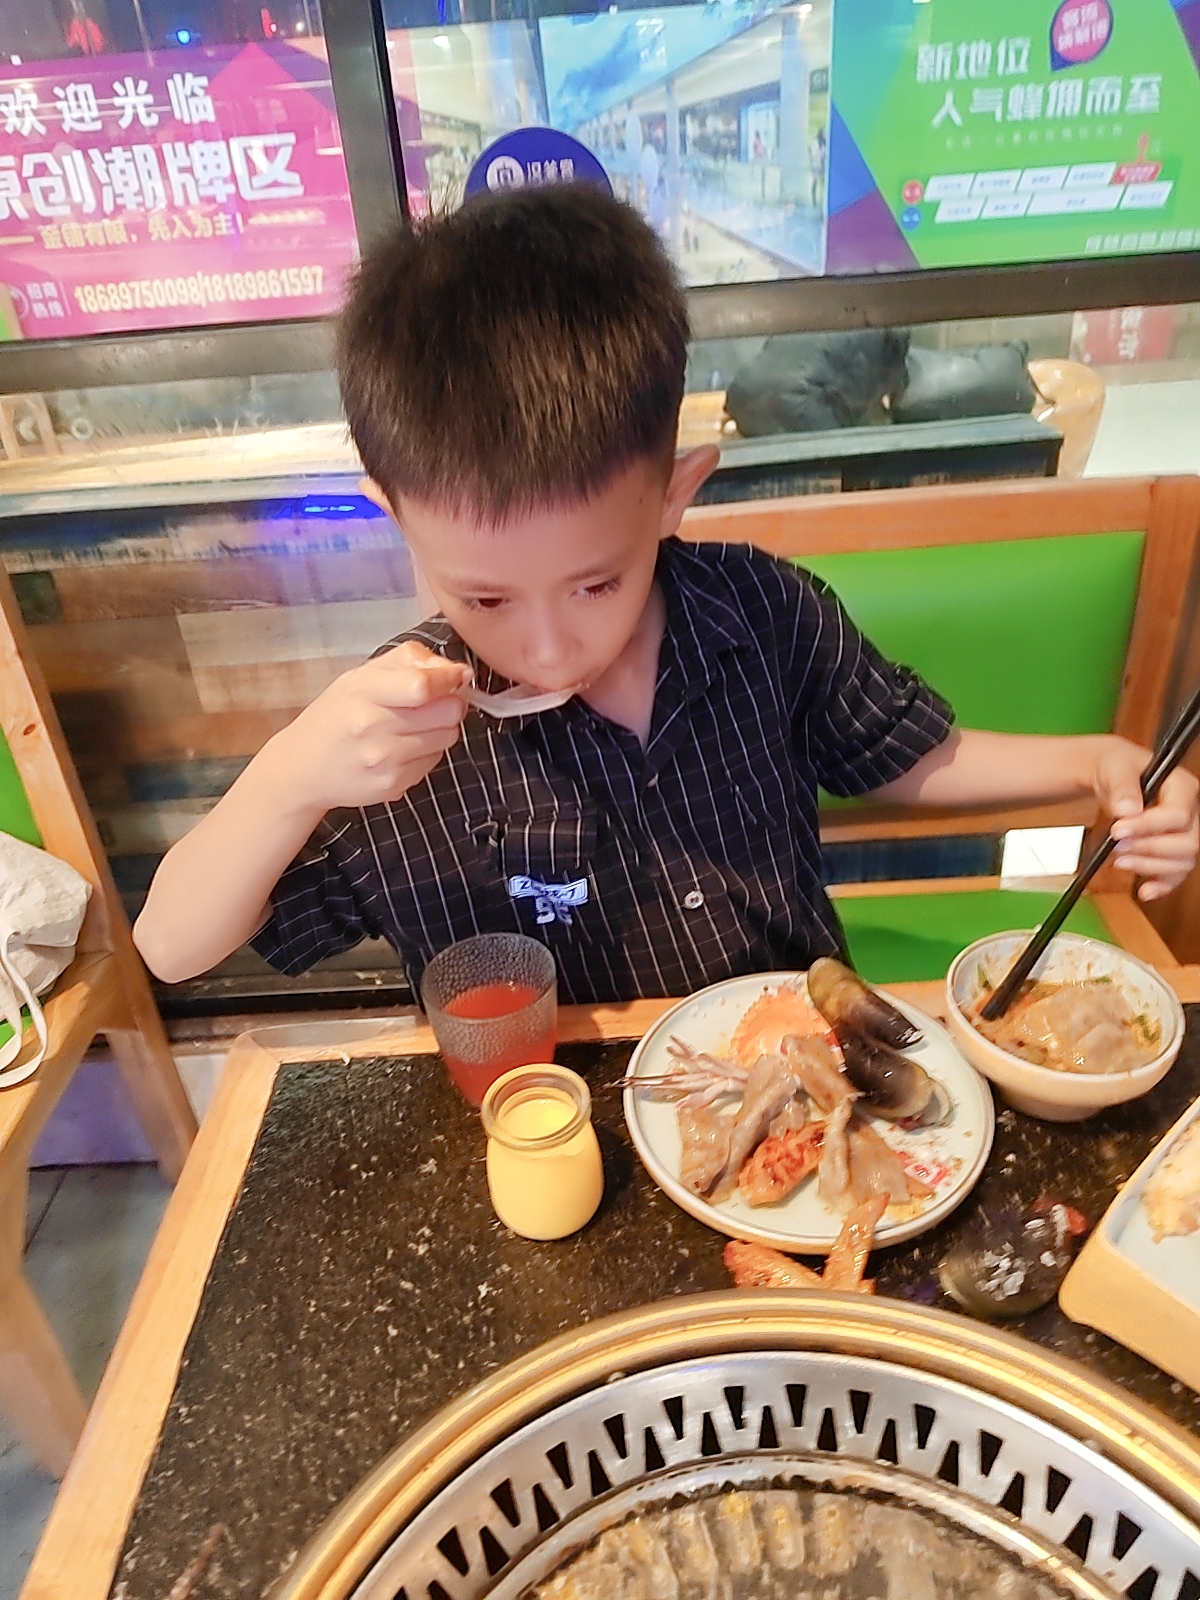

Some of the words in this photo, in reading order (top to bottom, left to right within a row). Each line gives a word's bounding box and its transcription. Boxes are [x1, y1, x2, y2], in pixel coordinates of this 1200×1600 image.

[915, 38, 1031, 83] 新地位
[0, 72, 216, 137] 欢迎光临
[931, 74, 1162, 128] 人气蜂拥而至
